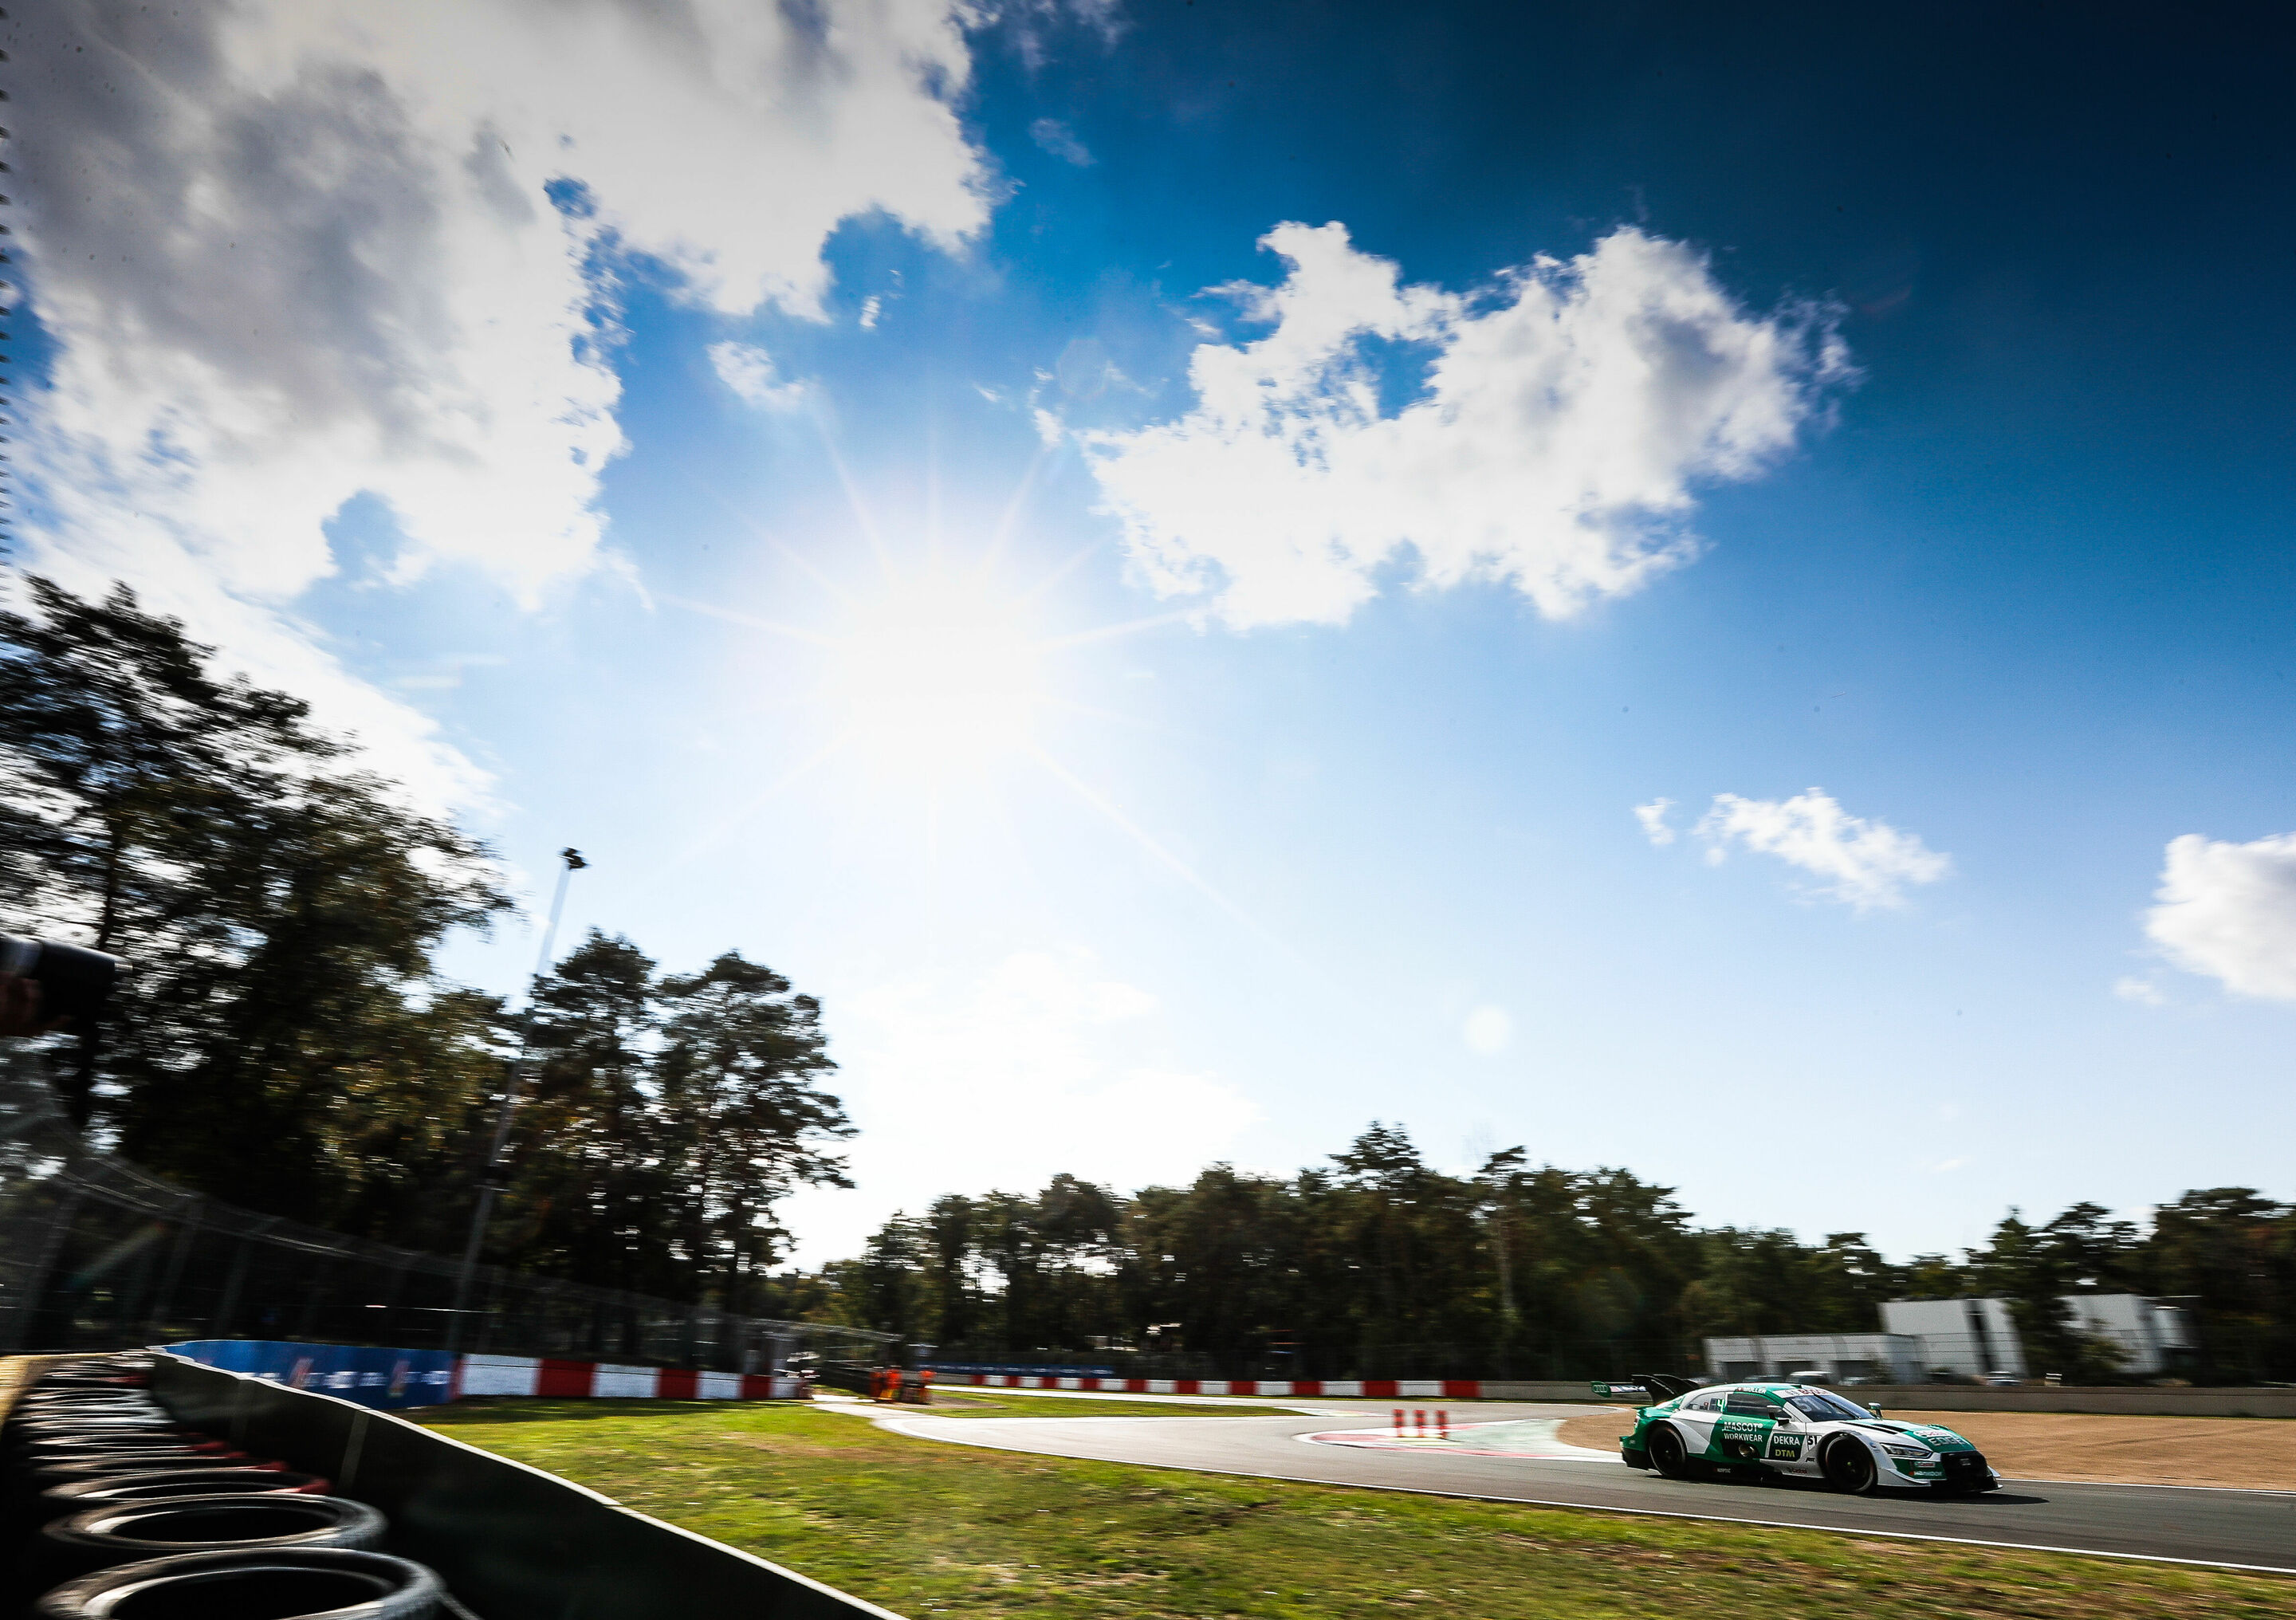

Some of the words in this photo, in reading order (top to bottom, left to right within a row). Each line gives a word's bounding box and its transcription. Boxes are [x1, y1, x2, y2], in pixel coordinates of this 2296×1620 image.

[1724, 1433, 1763, 1442] WORKWEAR
[1774, 1435, 1801, 1445] DEKRA
[1775, 1449, 1795, 1457] DTM
